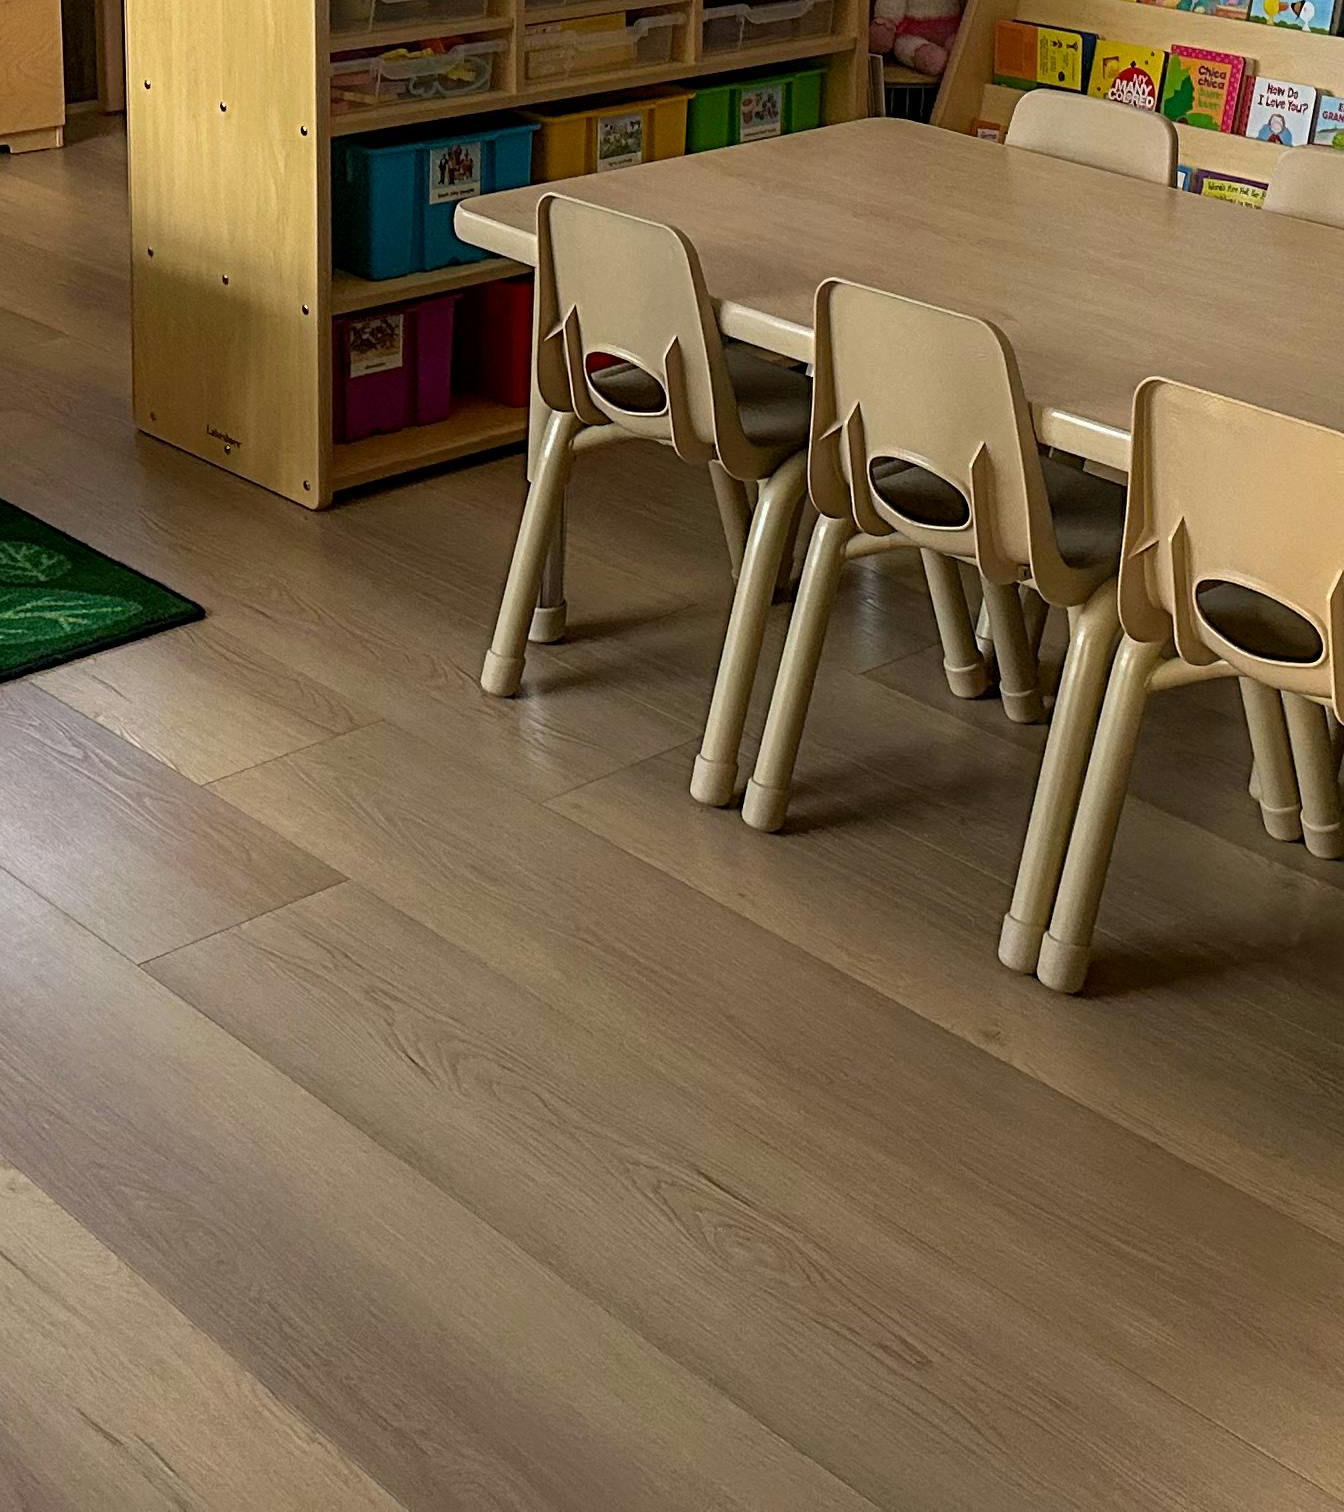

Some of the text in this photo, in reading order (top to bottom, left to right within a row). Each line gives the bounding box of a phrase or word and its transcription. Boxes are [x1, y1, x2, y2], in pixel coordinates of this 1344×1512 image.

[1132, 73, 1149, 84] MY
[1198, 65, 1227, 80] Chica
[1114, 78, 1153, 97] MANY
[1198, 77, 1225, 90] chica
[1108, 87, 1155, 109] COLORED
[1288, 87, 1299, 100] Do
[1257, 95, 1309, 115] I Love You?
